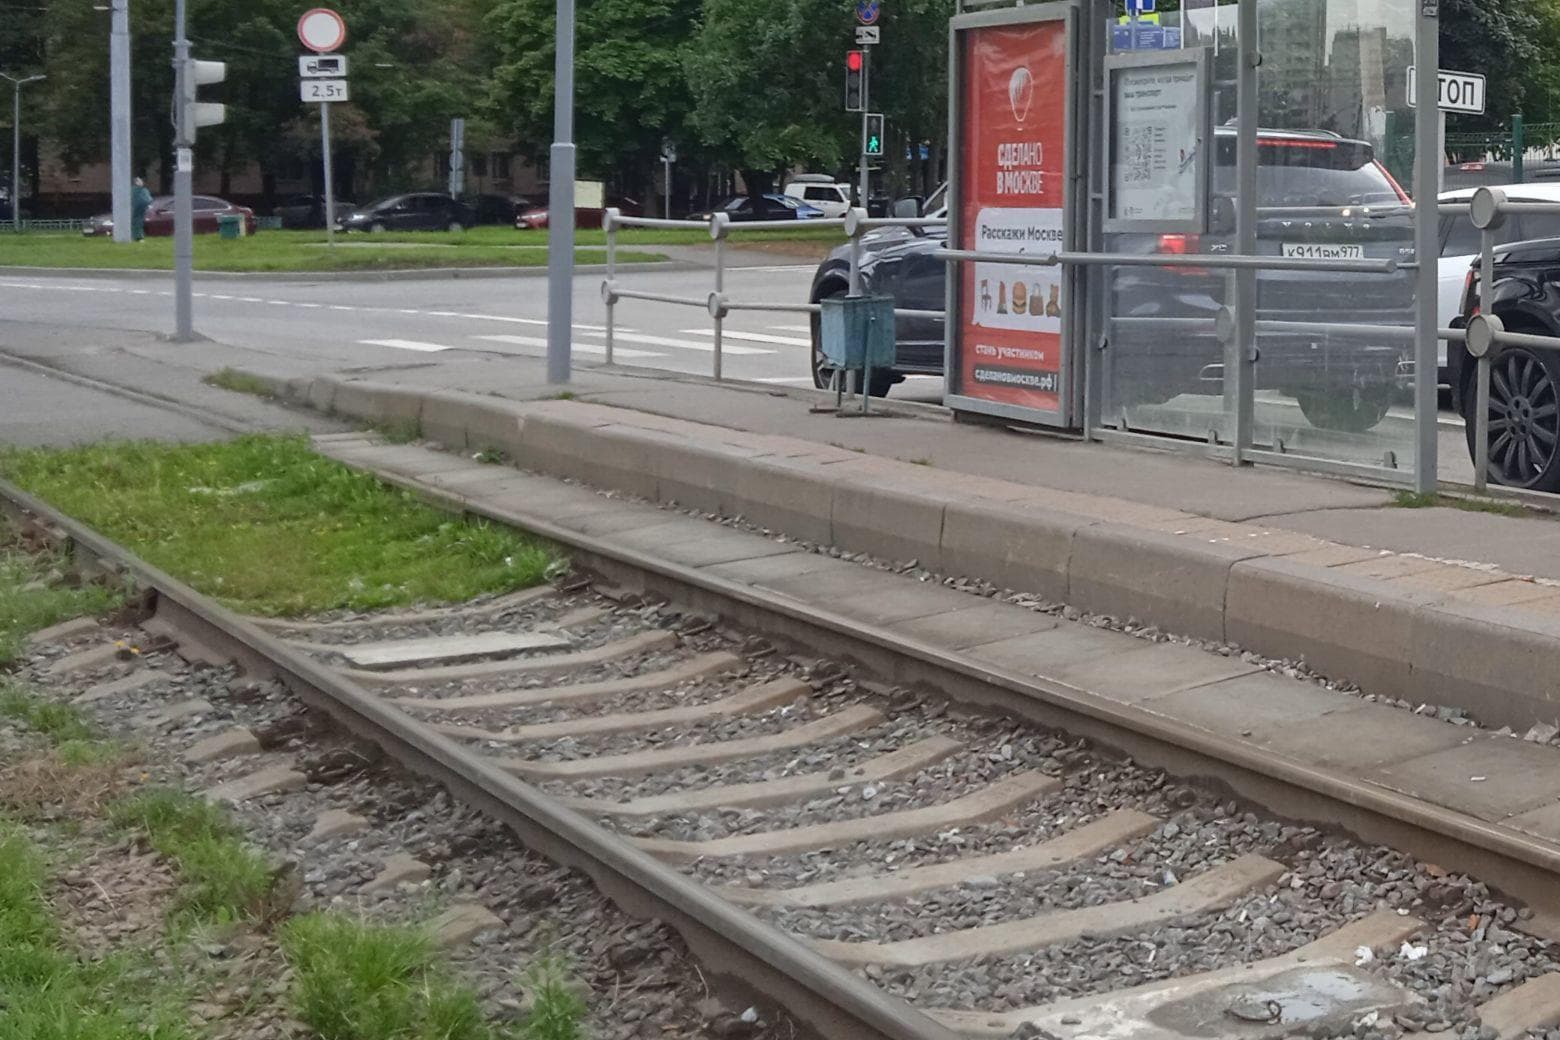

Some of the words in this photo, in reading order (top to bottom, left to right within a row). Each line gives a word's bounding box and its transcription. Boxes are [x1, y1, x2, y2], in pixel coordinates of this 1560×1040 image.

[997, 142, 1043, 170] СДЕЛАНО
[981, 224, 1026, 241] Расскажи
[1027, 225, 1063, 242] Москве
[1340, 245, 1360, 258] 977
